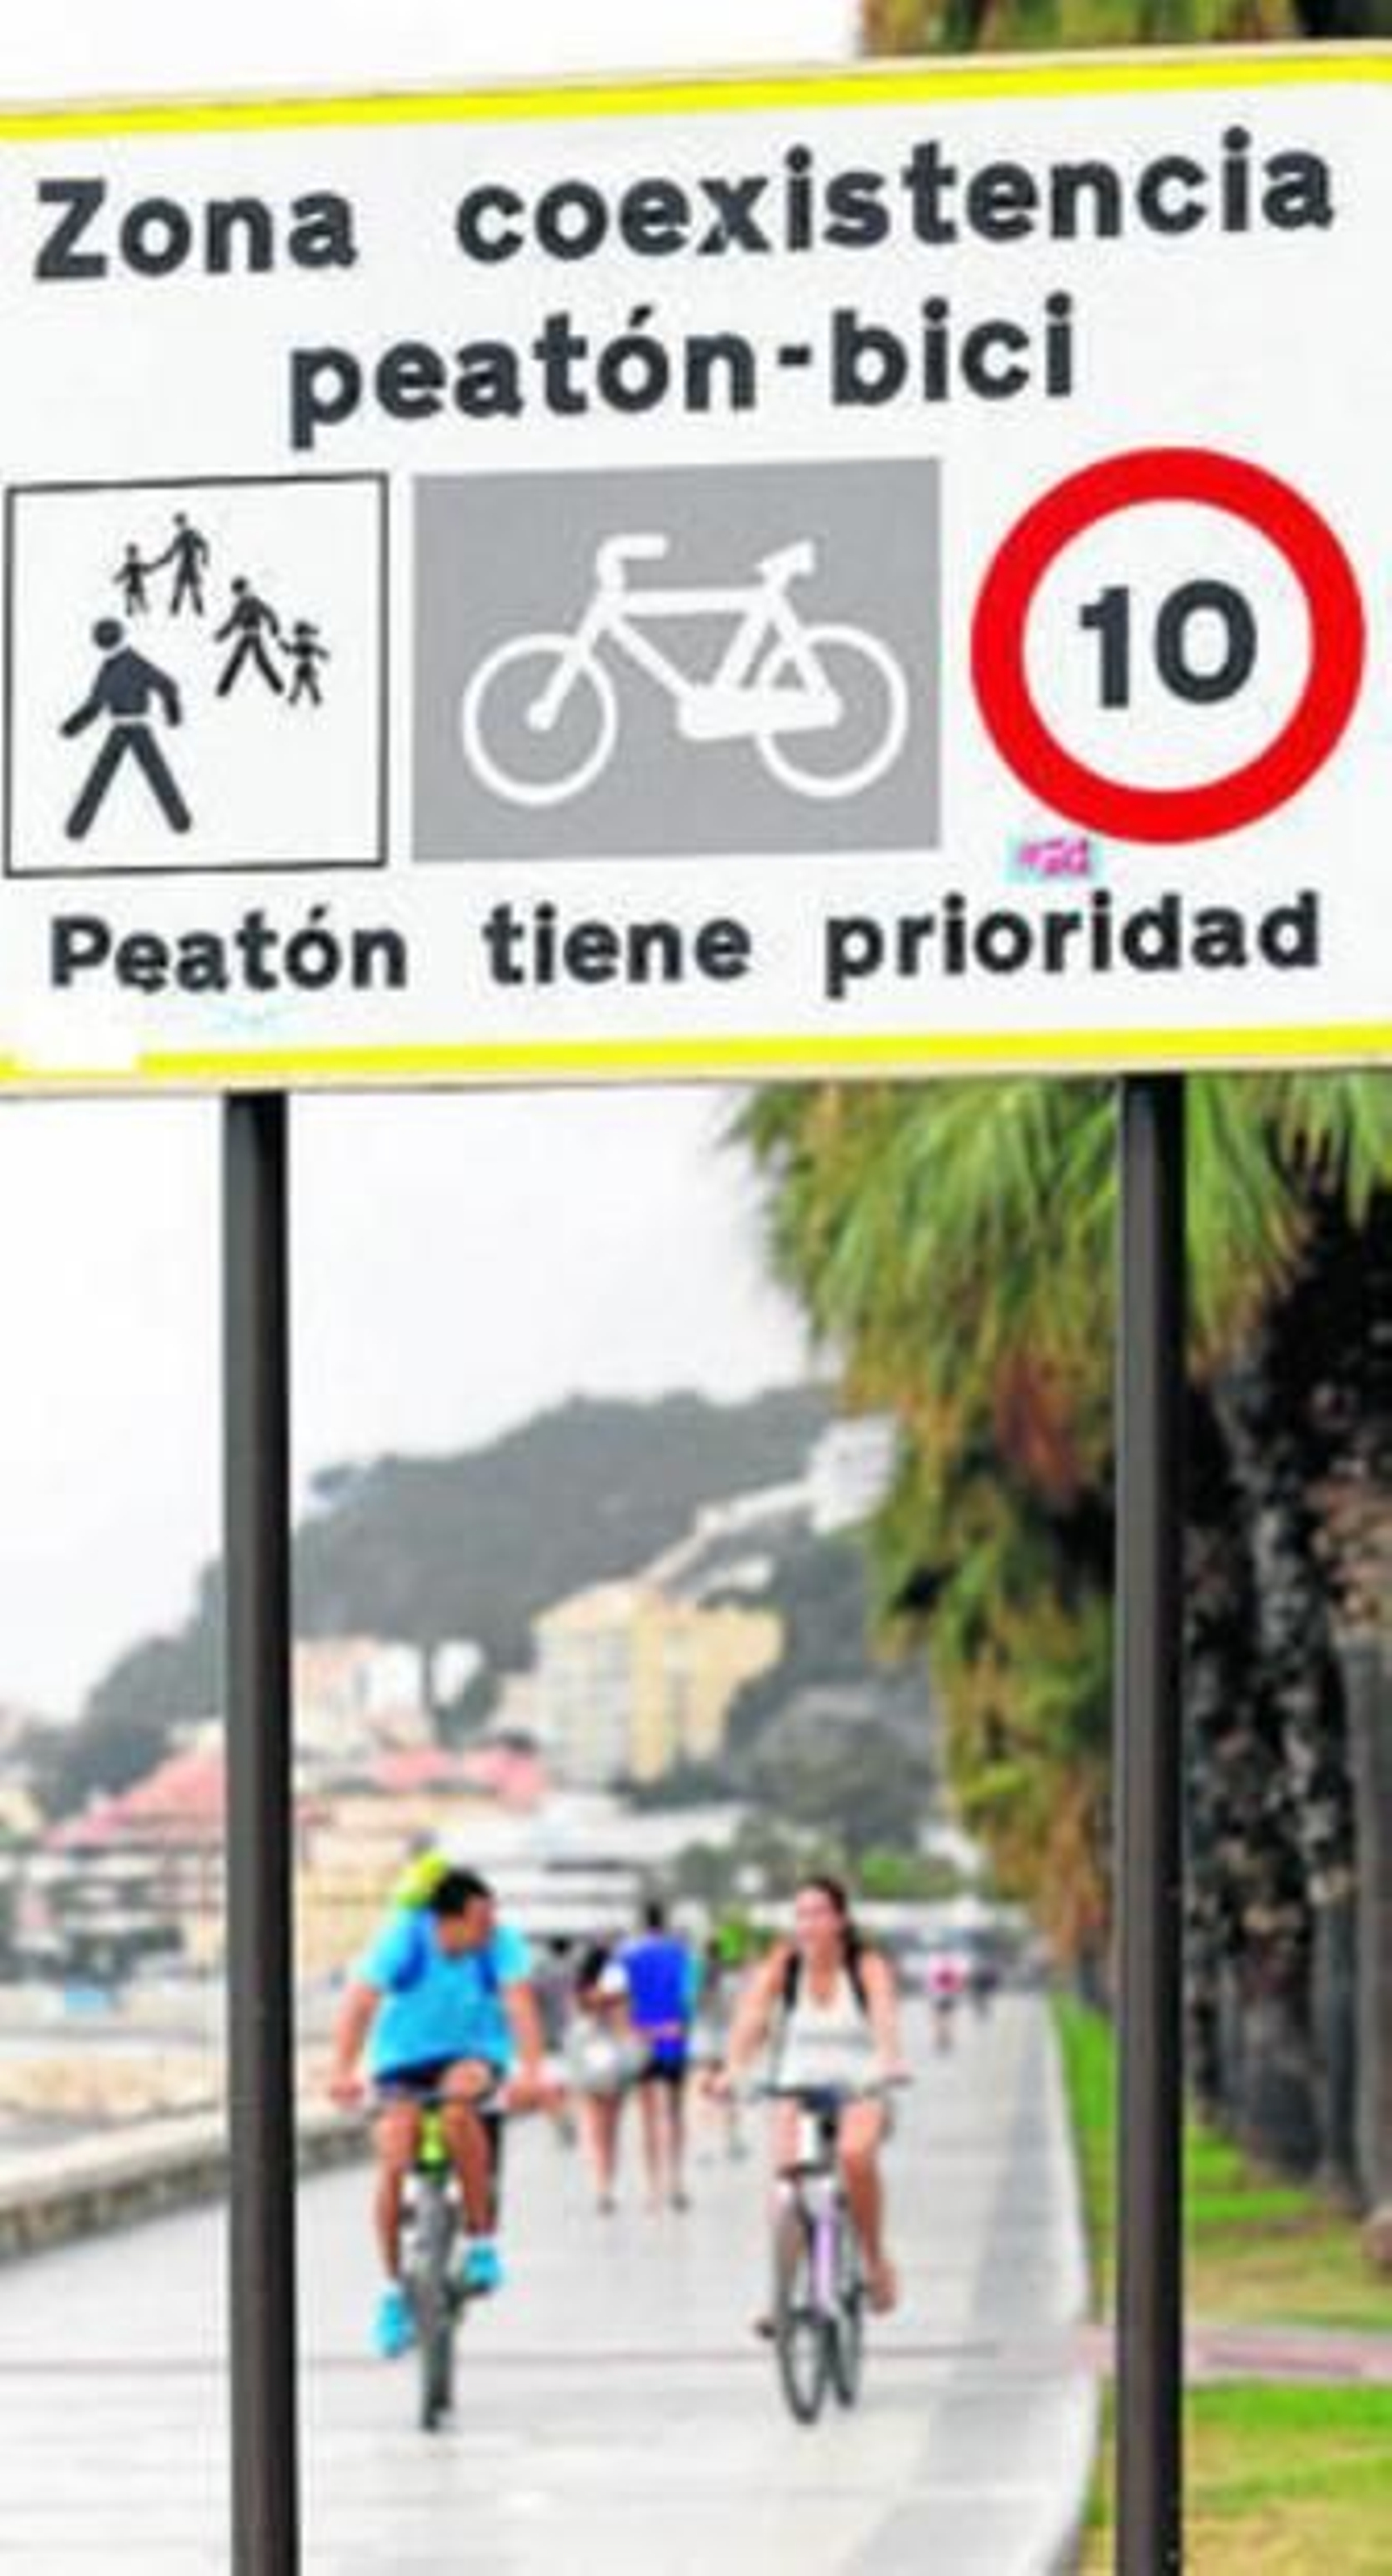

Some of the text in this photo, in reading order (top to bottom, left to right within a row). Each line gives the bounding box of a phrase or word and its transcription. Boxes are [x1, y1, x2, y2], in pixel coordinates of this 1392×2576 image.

[34, 126, 1335, 280] Zona coexistencia
[290, 291, 1074, 452] peatón-bici
[1079, 579, 1258, 710] 10
[51, 888, 1320, 1000] Peatón tiene prioridad
